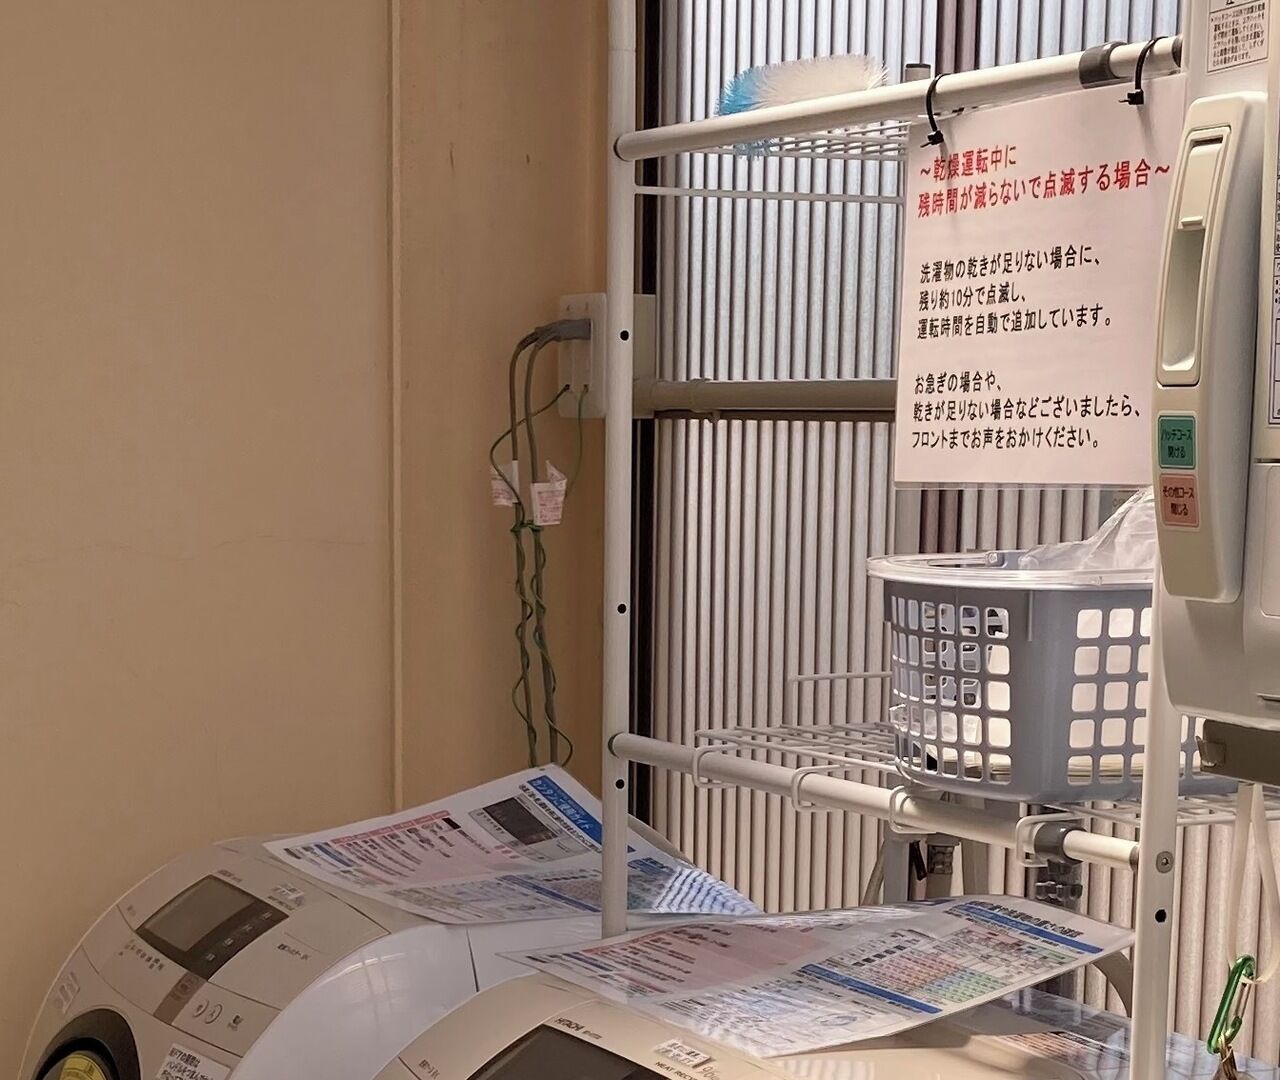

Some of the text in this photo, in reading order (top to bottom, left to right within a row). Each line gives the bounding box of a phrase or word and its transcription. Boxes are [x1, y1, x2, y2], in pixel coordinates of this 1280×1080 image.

[920, 244, 1101, 283] 洗濯物の乾きが足りない場合に、
[916, 303, 1112, 340] 運転時間を自動で追加しています。
[914, 370, 1002, 393] お急ぎの場合や、
[913, 394, 1141, 422] 乾きが足りない場合などございましたら、
[911, 426, 1098, 450] フロントまでお声をおかけください。
